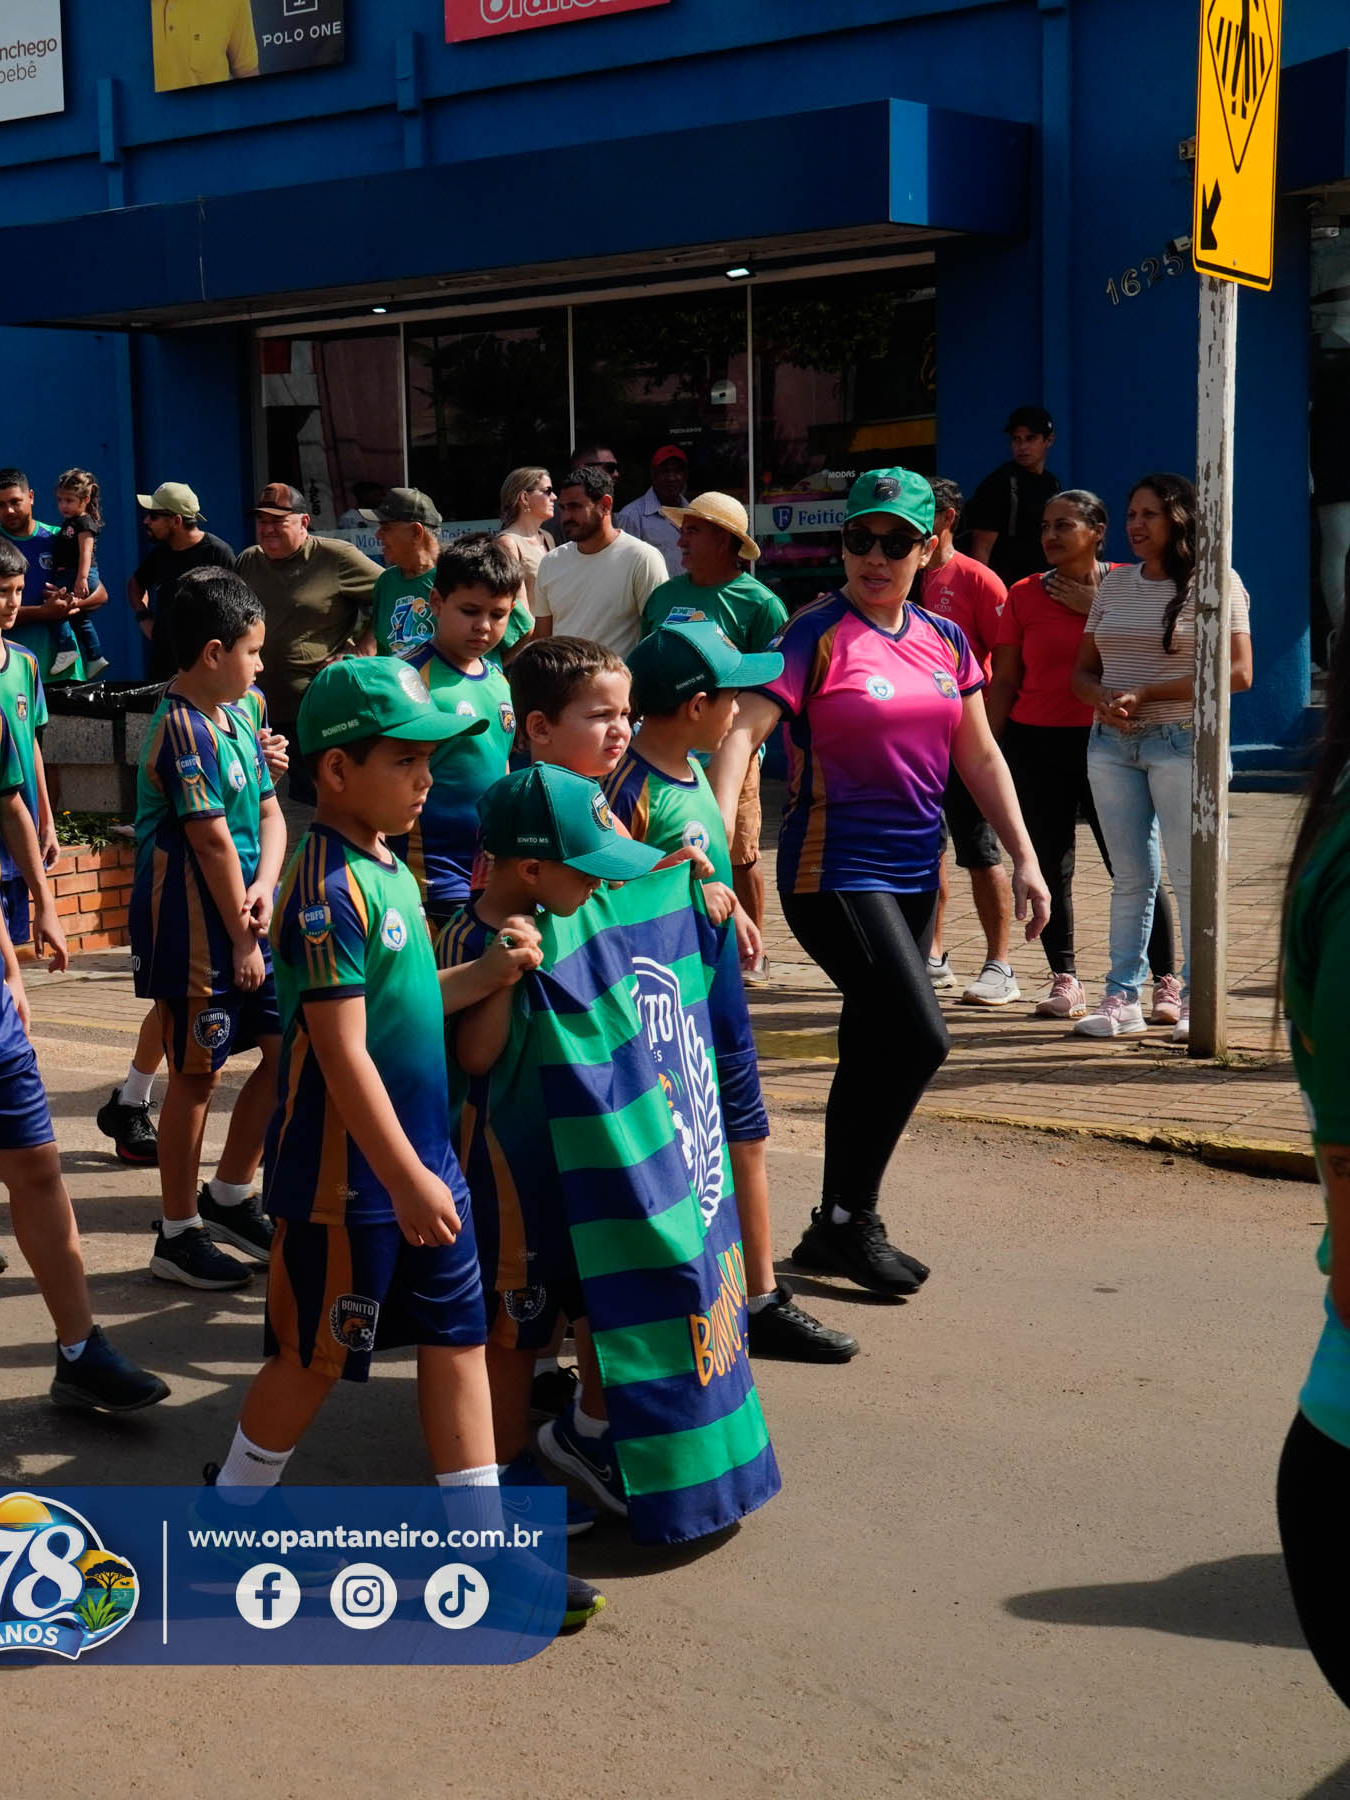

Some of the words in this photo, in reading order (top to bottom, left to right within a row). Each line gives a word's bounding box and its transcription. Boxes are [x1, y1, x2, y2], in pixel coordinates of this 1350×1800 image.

[262, 28, 304, 48] POLO
[309, 20, 342, 38] ONE
[321, 723, 348, 738] BONITO
[347, 718, 360, 729] MS
[304, 909, 324, 923] CBFS
[341, 1299, 375, 1317] BONITO
